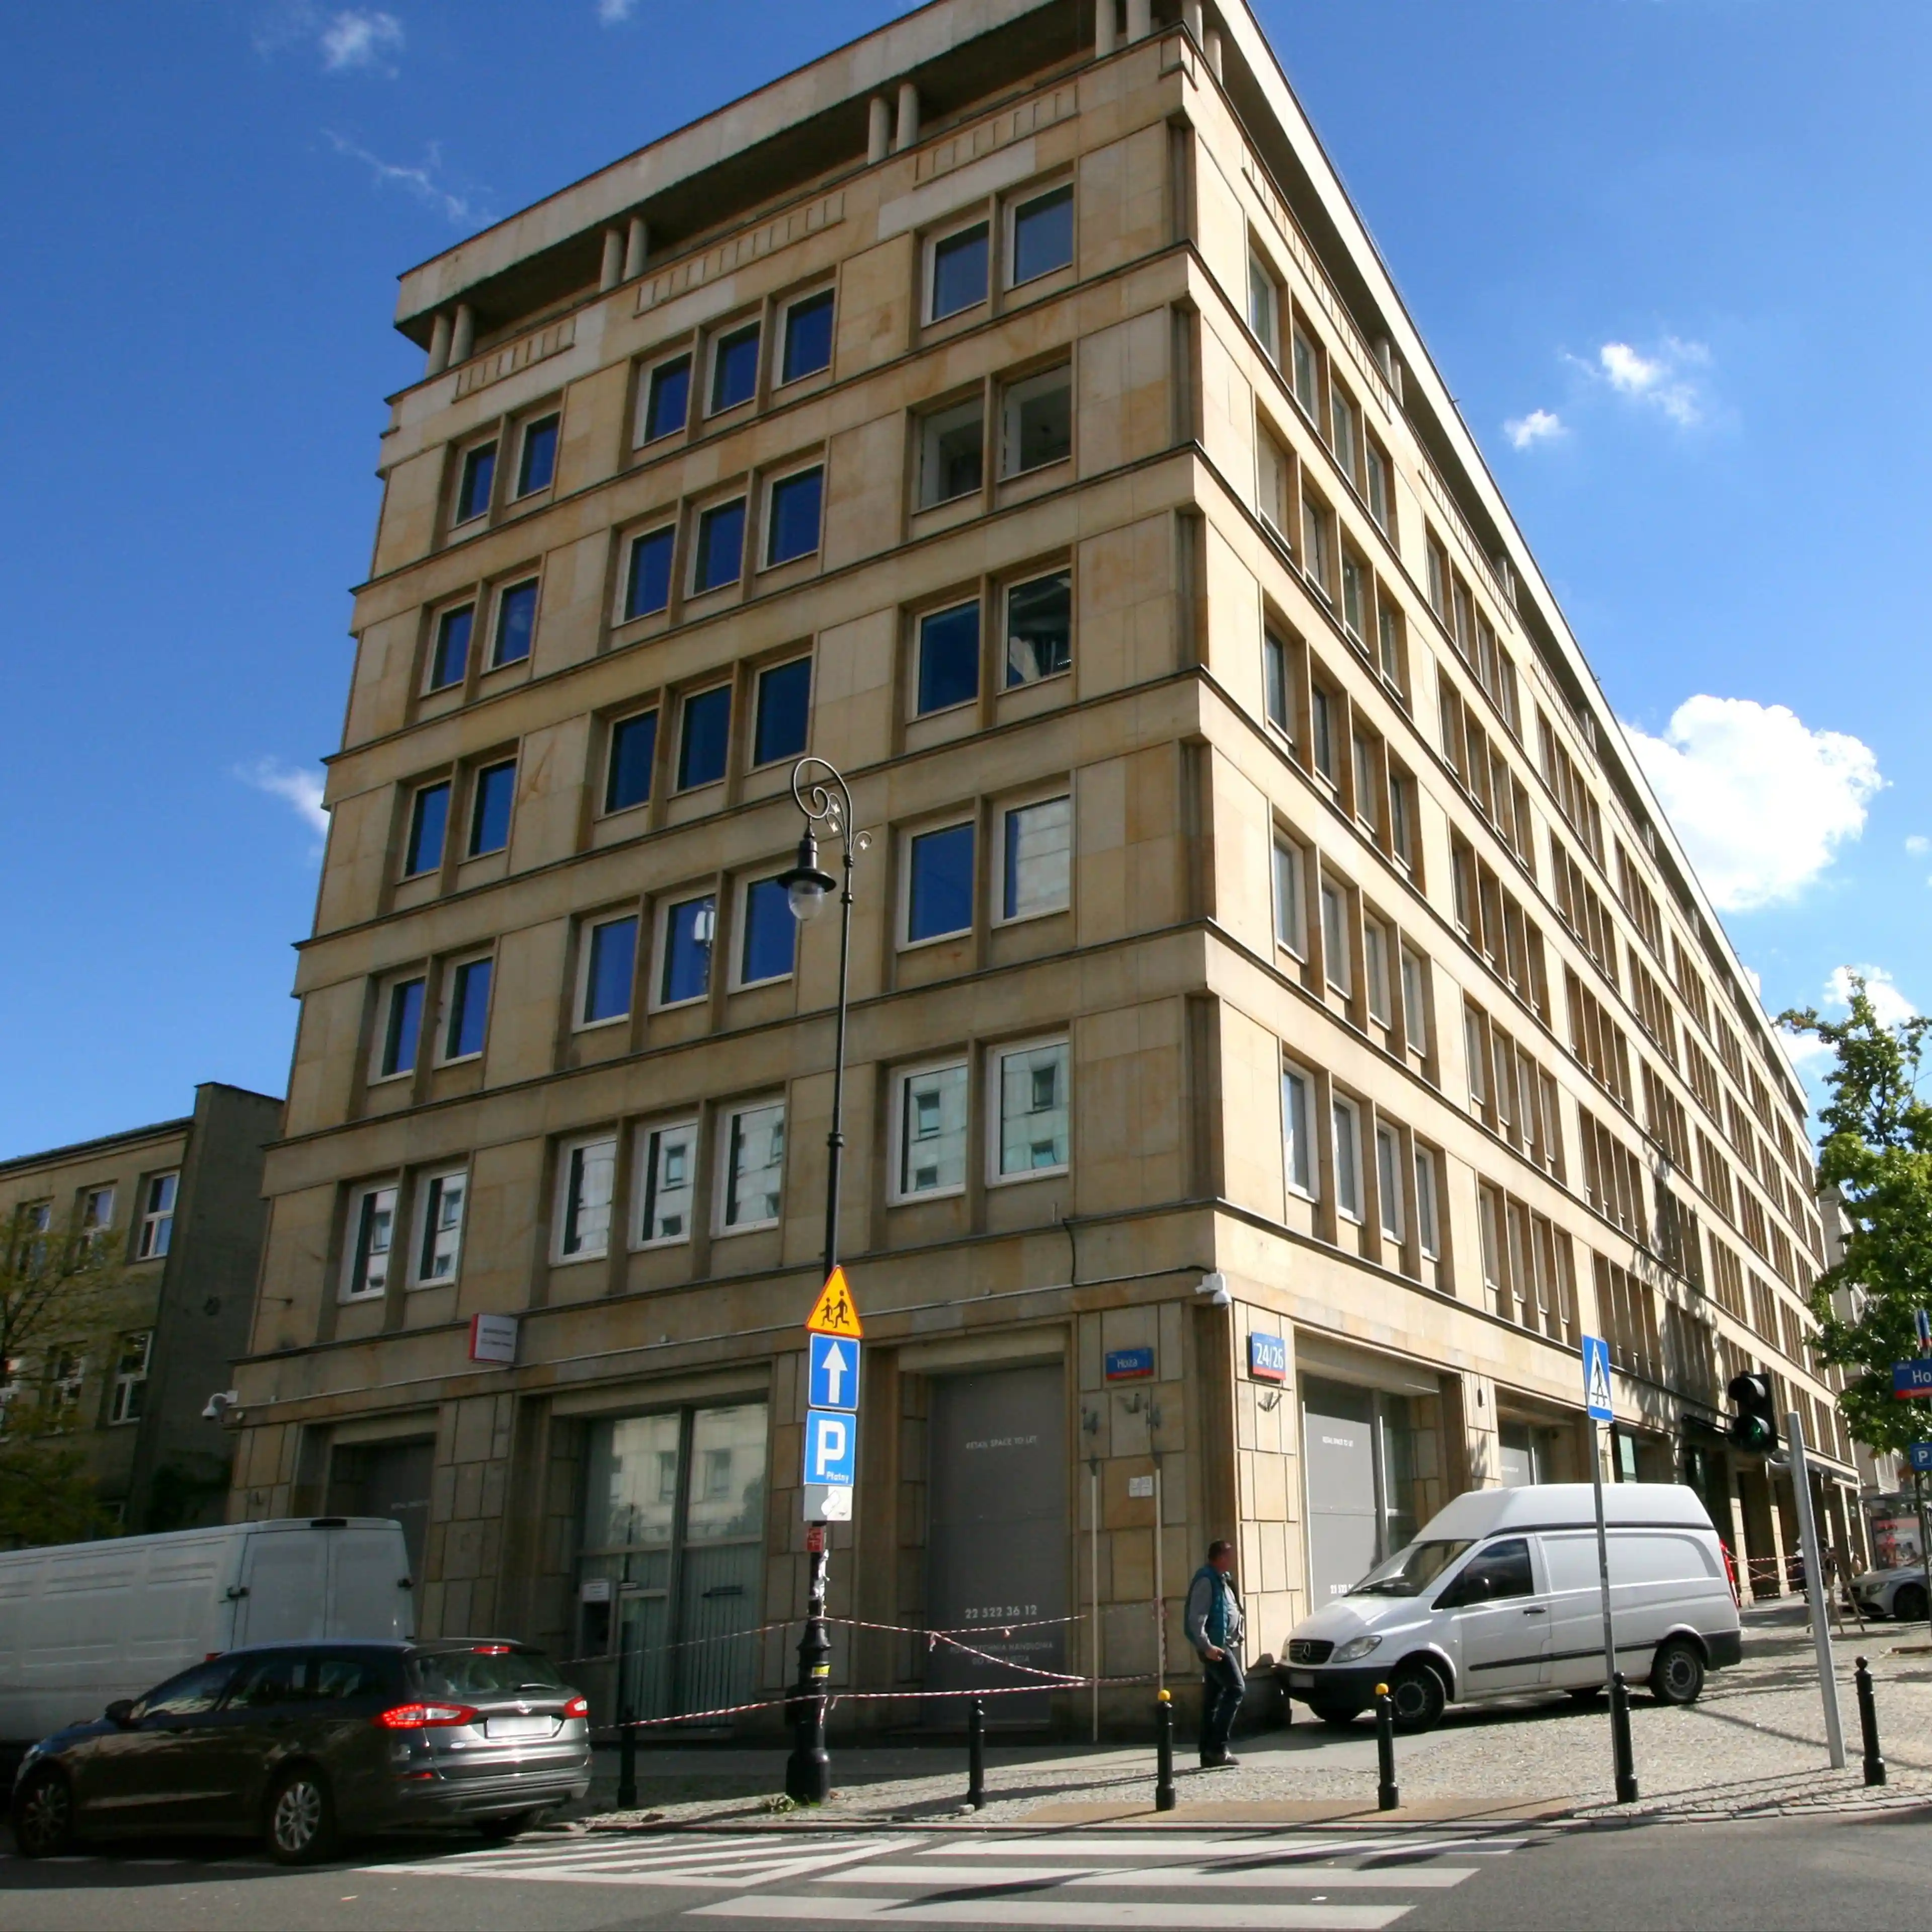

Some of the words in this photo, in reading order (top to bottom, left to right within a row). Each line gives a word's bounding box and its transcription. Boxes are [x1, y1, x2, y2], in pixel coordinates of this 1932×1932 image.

[1255, 1343, 1284, 1370] 24/26
[817, 1420, 846, 1475] P
[1918, 1450, 1928, 1463] P
[965, 1608, 979, 1619] 22
[982, 1607, 1002, 1618] 522
[1006, 1605, 1020, 1616] 36
[1025, 1605, 1037, 1616] 12
